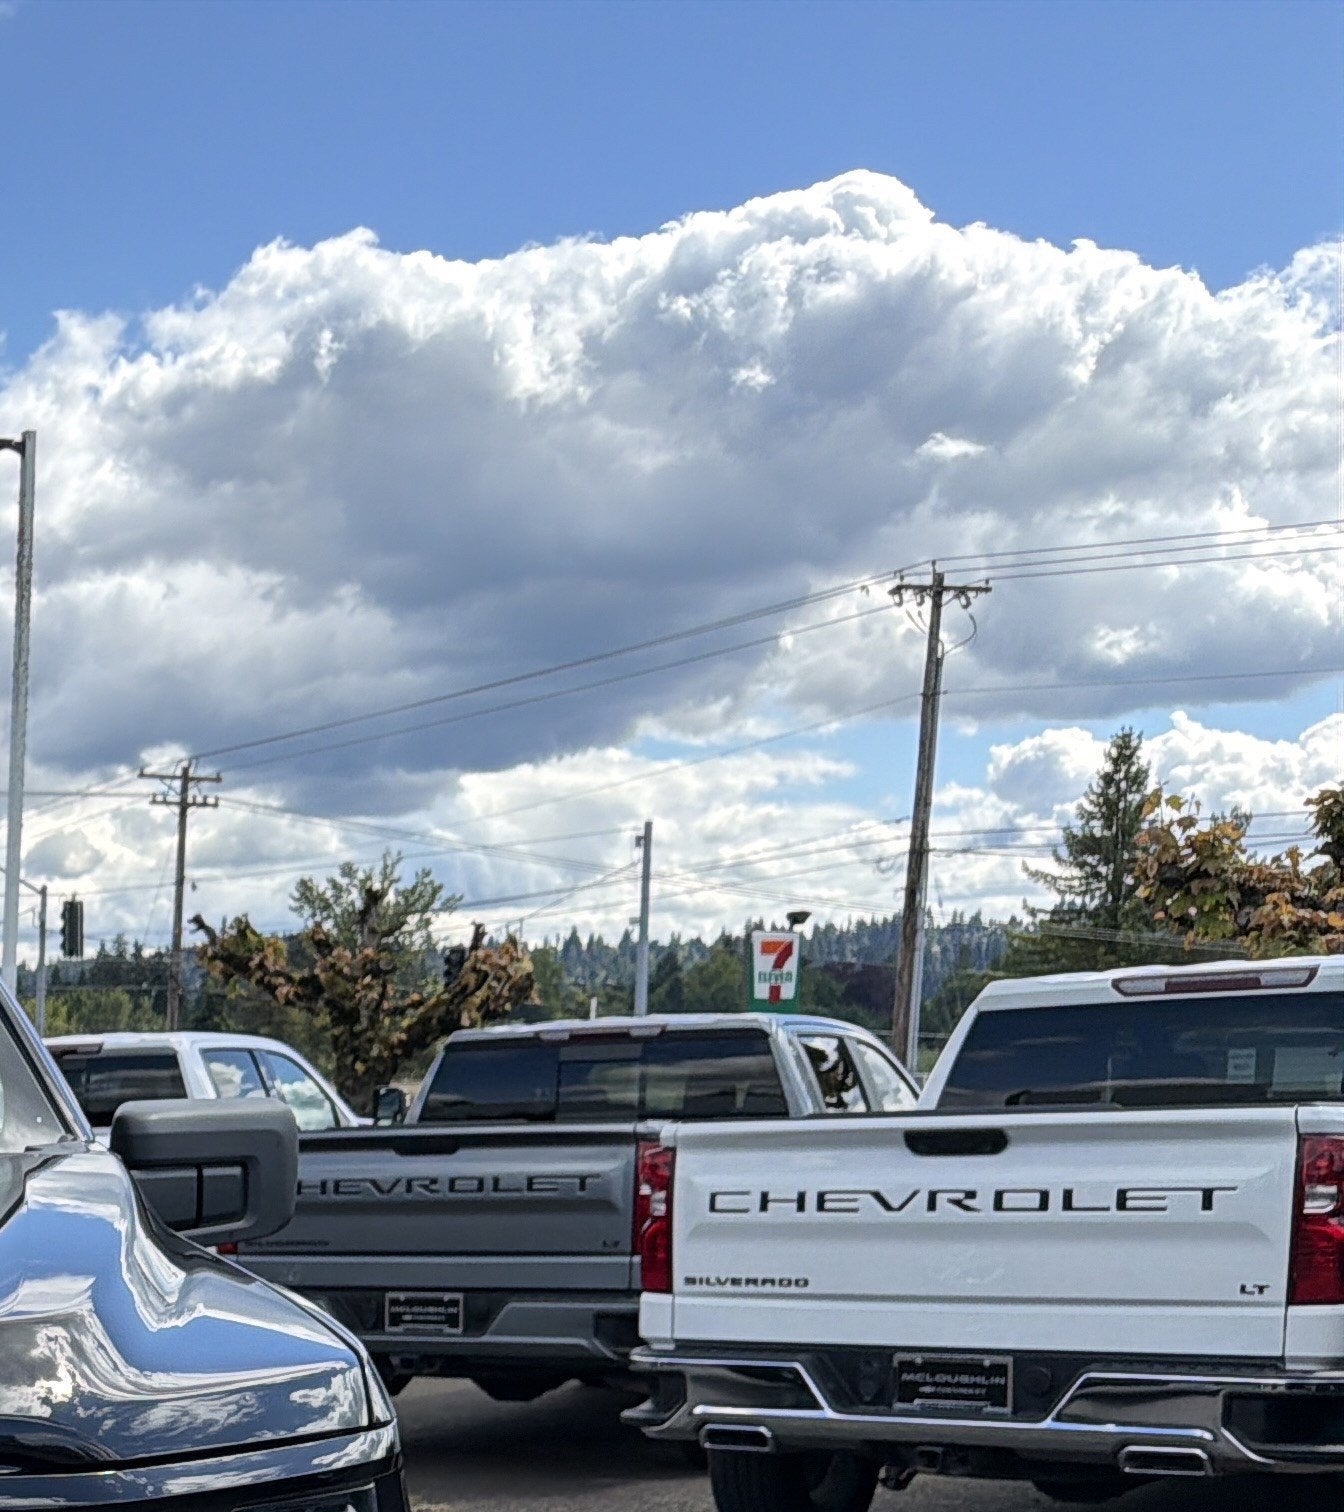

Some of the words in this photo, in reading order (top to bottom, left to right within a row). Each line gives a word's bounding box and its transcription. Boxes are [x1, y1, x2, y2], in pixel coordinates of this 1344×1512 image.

[296, 1173, 602, 1196] HEVROLET
[708, 1185, 1238, 1213] CHEVROLET
[684, 1276, 810, 1289] SILVERADO
[1240, 1284, 1270, 1296] LT
